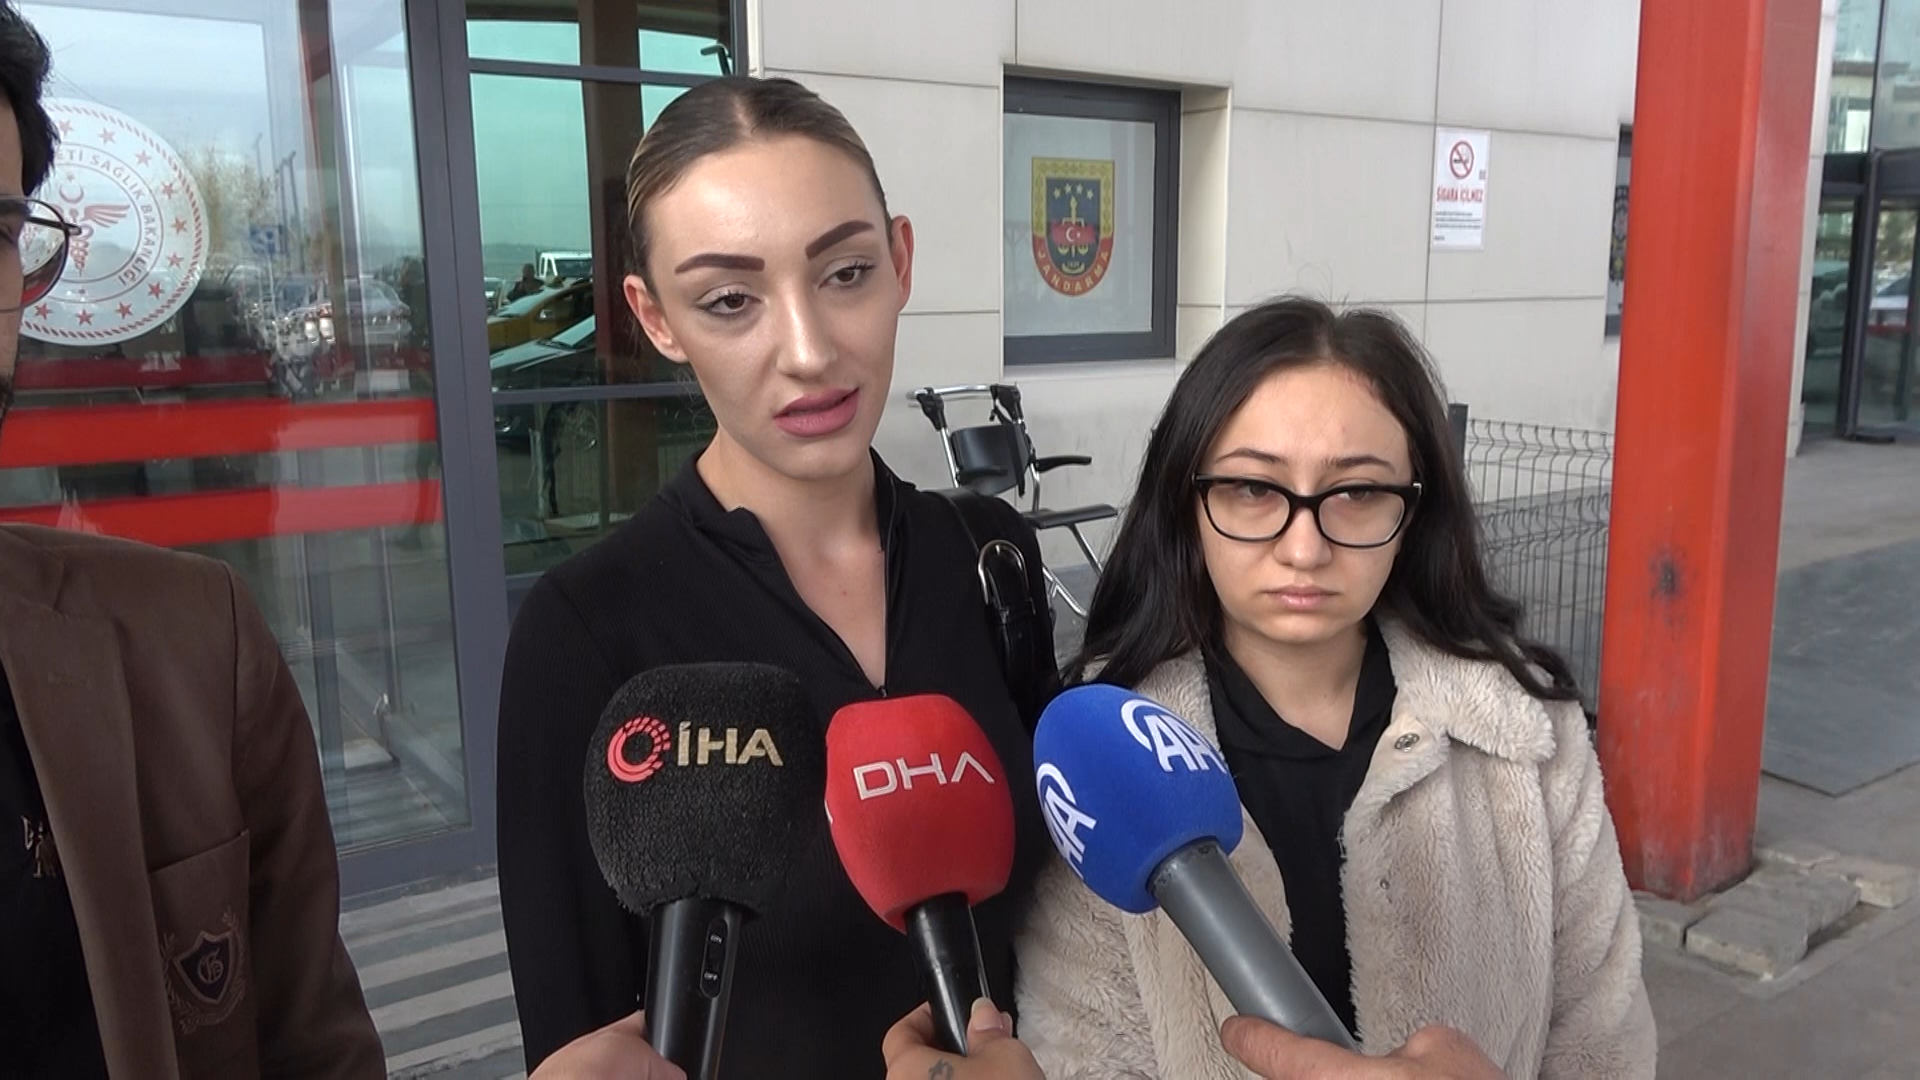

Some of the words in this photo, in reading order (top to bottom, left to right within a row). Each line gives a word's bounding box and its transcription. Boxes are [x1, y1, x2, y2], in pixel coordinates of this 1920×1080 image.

[90, 153, 146, 200] SAĞLIK
[118, 204, 157, 286] BAKANLIĞI
[1037, 250, 1109, 292] JANDARMA
[677, 720, 784, 767] İHA
[1143, 714, 1228, 775] AA
[853, 751, 995, 800] DHA
